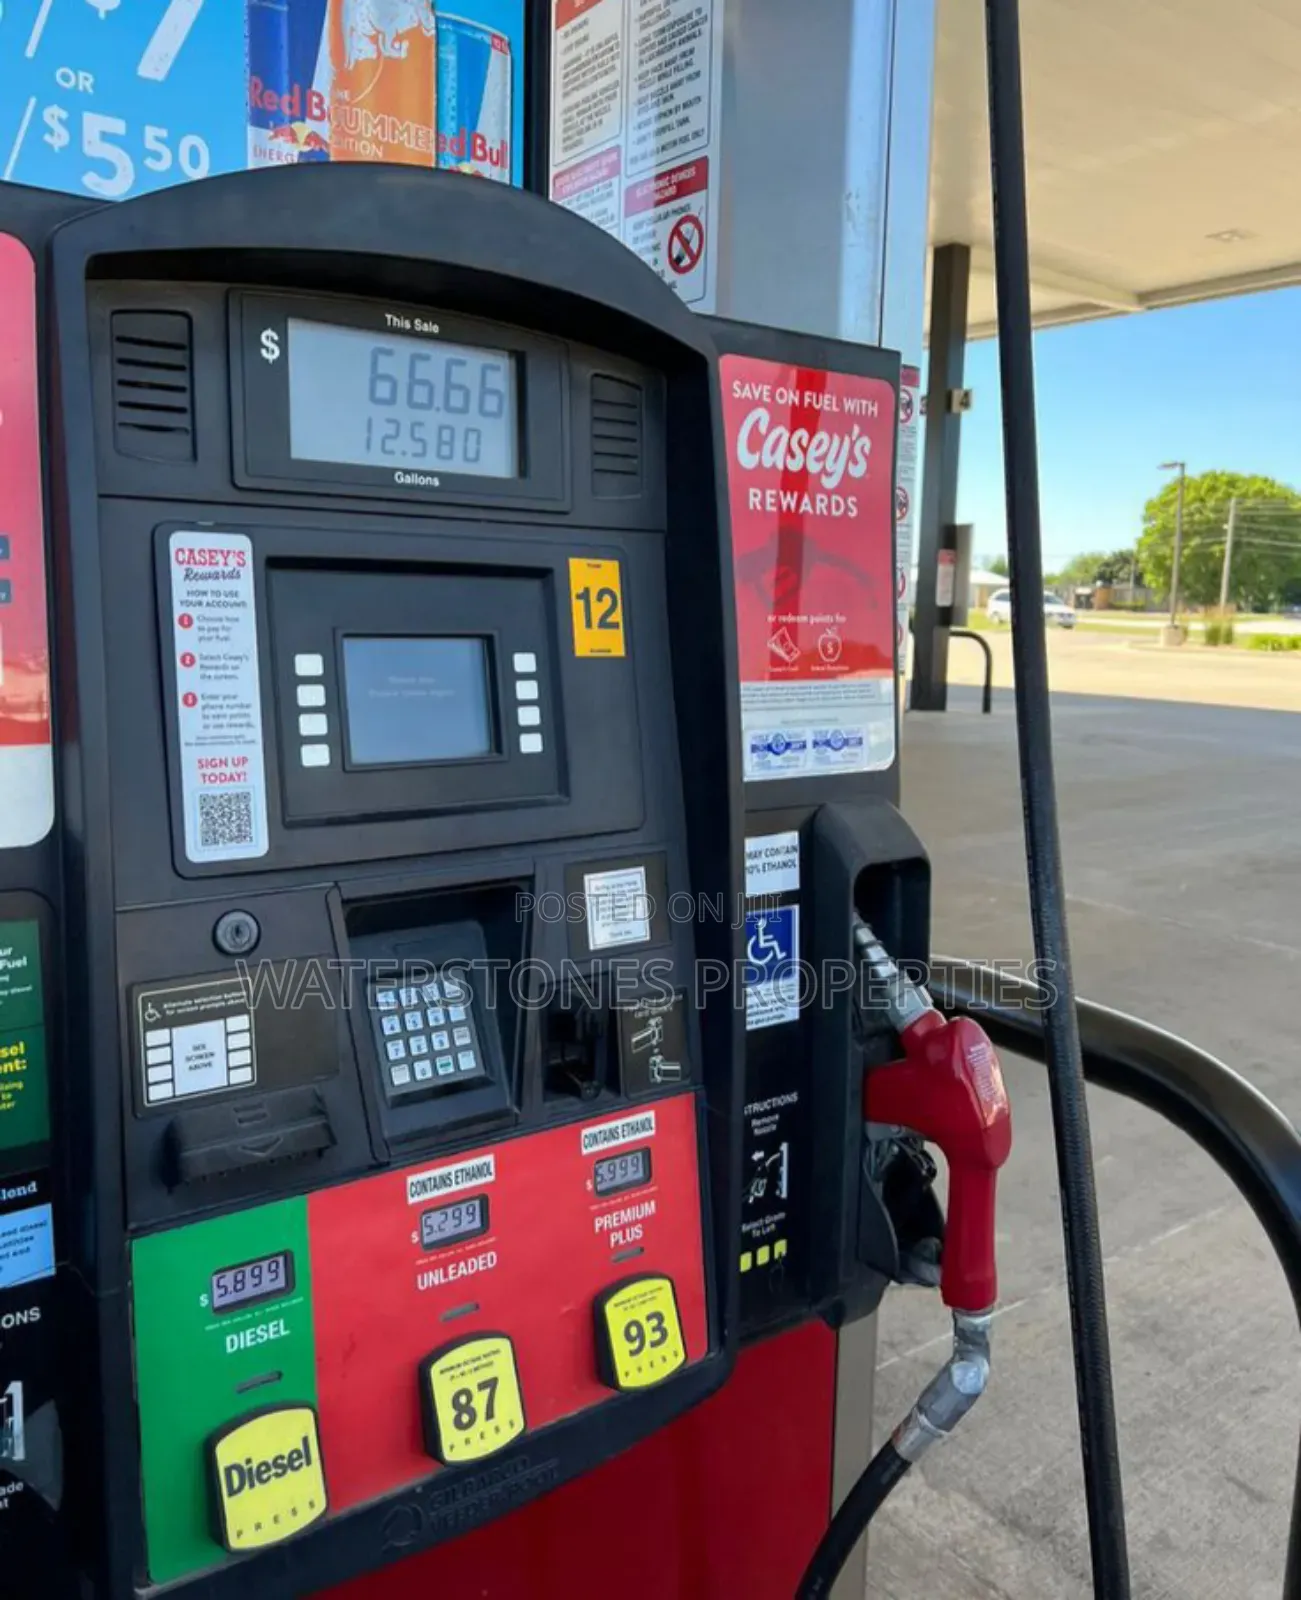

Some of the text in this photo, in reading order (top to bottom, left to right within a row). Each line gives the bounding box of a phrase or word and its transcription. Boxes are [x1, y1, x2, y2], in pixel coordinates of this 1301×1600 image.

[56, 67, 95, 95] OR
[250, 75, 332, 122] Red B
[253, 144, 295, 162] ENERG
[437, 127, 466, 157] ed
[385, 314, 439, 333] This Sale
[260, 328, 281, 364] $
[368, 346, 505, 420] 66.66
[732, 380, 878, 418] SAVE ON FUEL WITH
[366, 416, 482, 463] 12.580
[736, 406, 871, 489] Casey's
[394, 471, 440, 487] Gallons
[748, 487, 858, 518] REWARDS
[175, 548, 247, 568] CASEY'S
[184, 567, 241, 583] Rewards
[180, 600, 203, 608] YOUR
[187, 590, 239, 598] HOW TO USE
[575, 586, 620, 630] 12
[198, 756, 248, 770] SIGN UP
[201, 772, 247, 784] TODAY!
[762, 859, 796, 873] ETHANOL
[582, 1115, 654, 1150] CONTAINS ETHANOL
[1, 1181, 37, 1200] lend
[409, 1159, 494, 1199] CONTAINS ETHANOL
[423, 1203, 477, 1238] 5.299
[594, 1200, 657, 1233] PREMIUM
[610, 1225, 643, 1248] PLUS
[216, 1259, 281, 1299] 5.899
[416, 1251, 497, 1291] UNLEADED
[1, 1306, 41, 1329] ONS
[623, 1310, 668, 1357] 93
[225, 1318, 291, 1353] DIESEL
[451, 1376, 499, 1432] 87
[224, 1435, 313, 1498] Diesel
[0, 1481, 24, 1496] ade
[236, 1499, 315, 1540] PRESS
